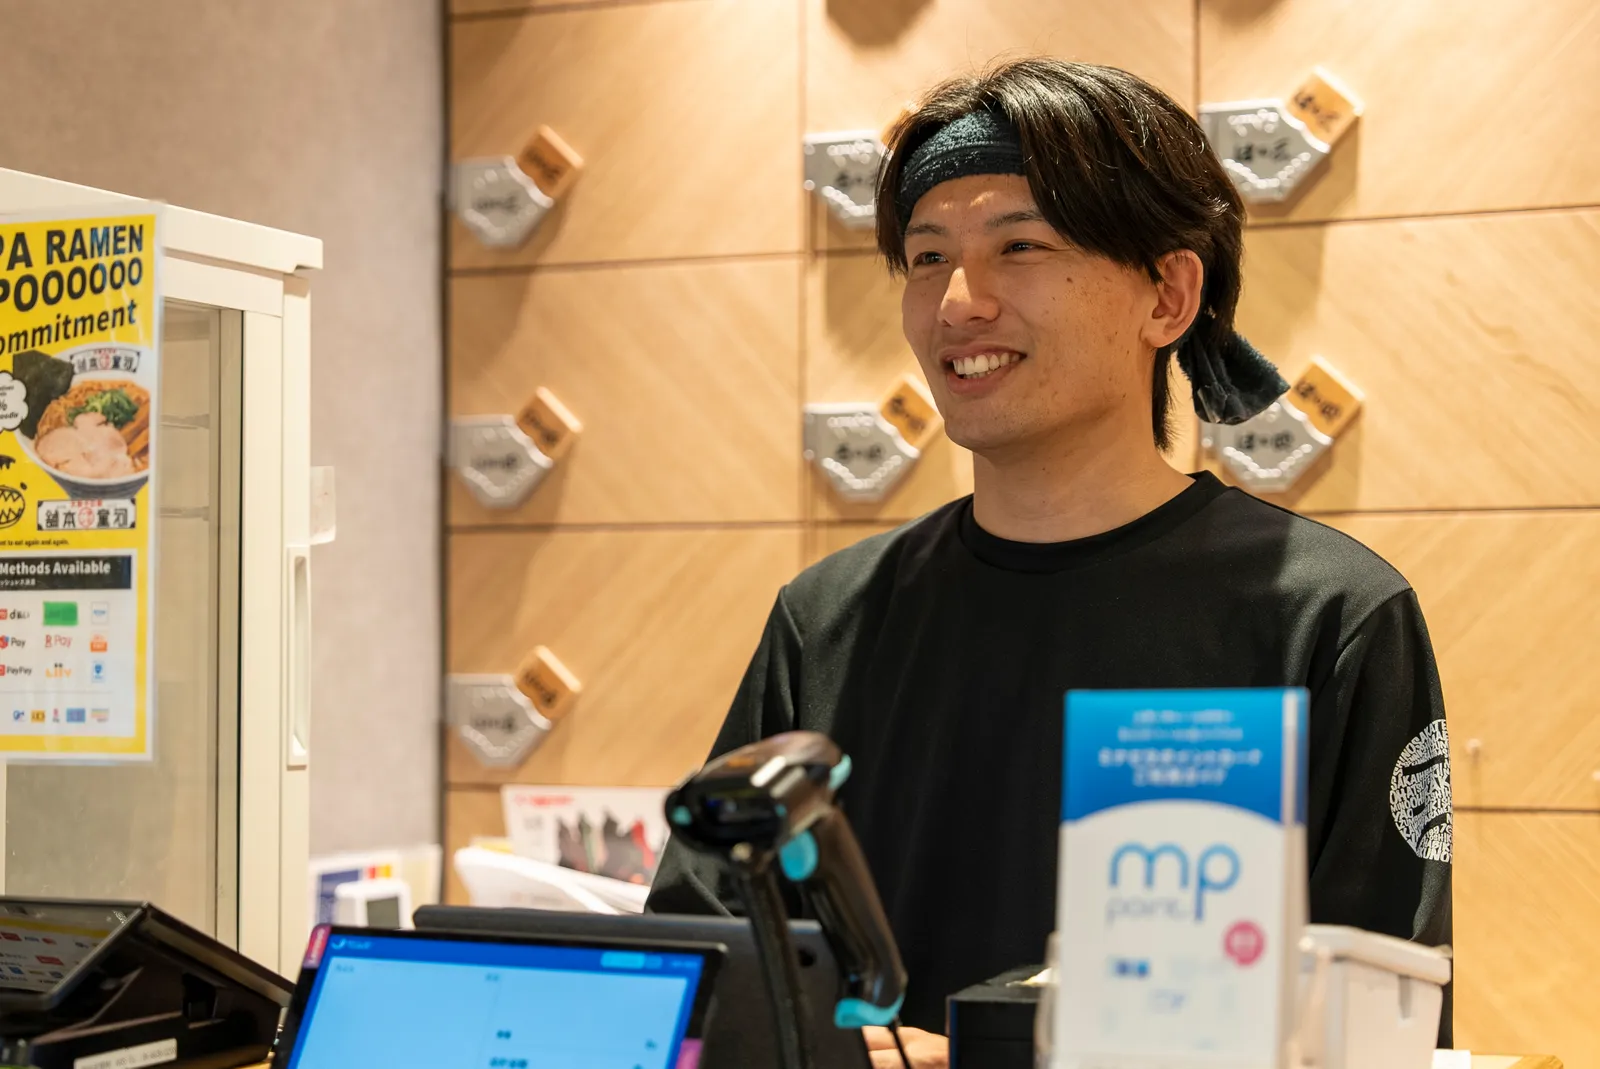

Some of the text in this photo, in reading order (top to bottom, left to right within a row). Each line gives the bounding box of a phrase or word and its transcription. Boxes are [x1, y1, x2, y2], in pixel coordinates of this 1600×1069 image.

[0, 224, 143, 271] A RAMEN
[0, 560, 111, 575] Methods Available
[1109, 842, 1240, 922] mp
